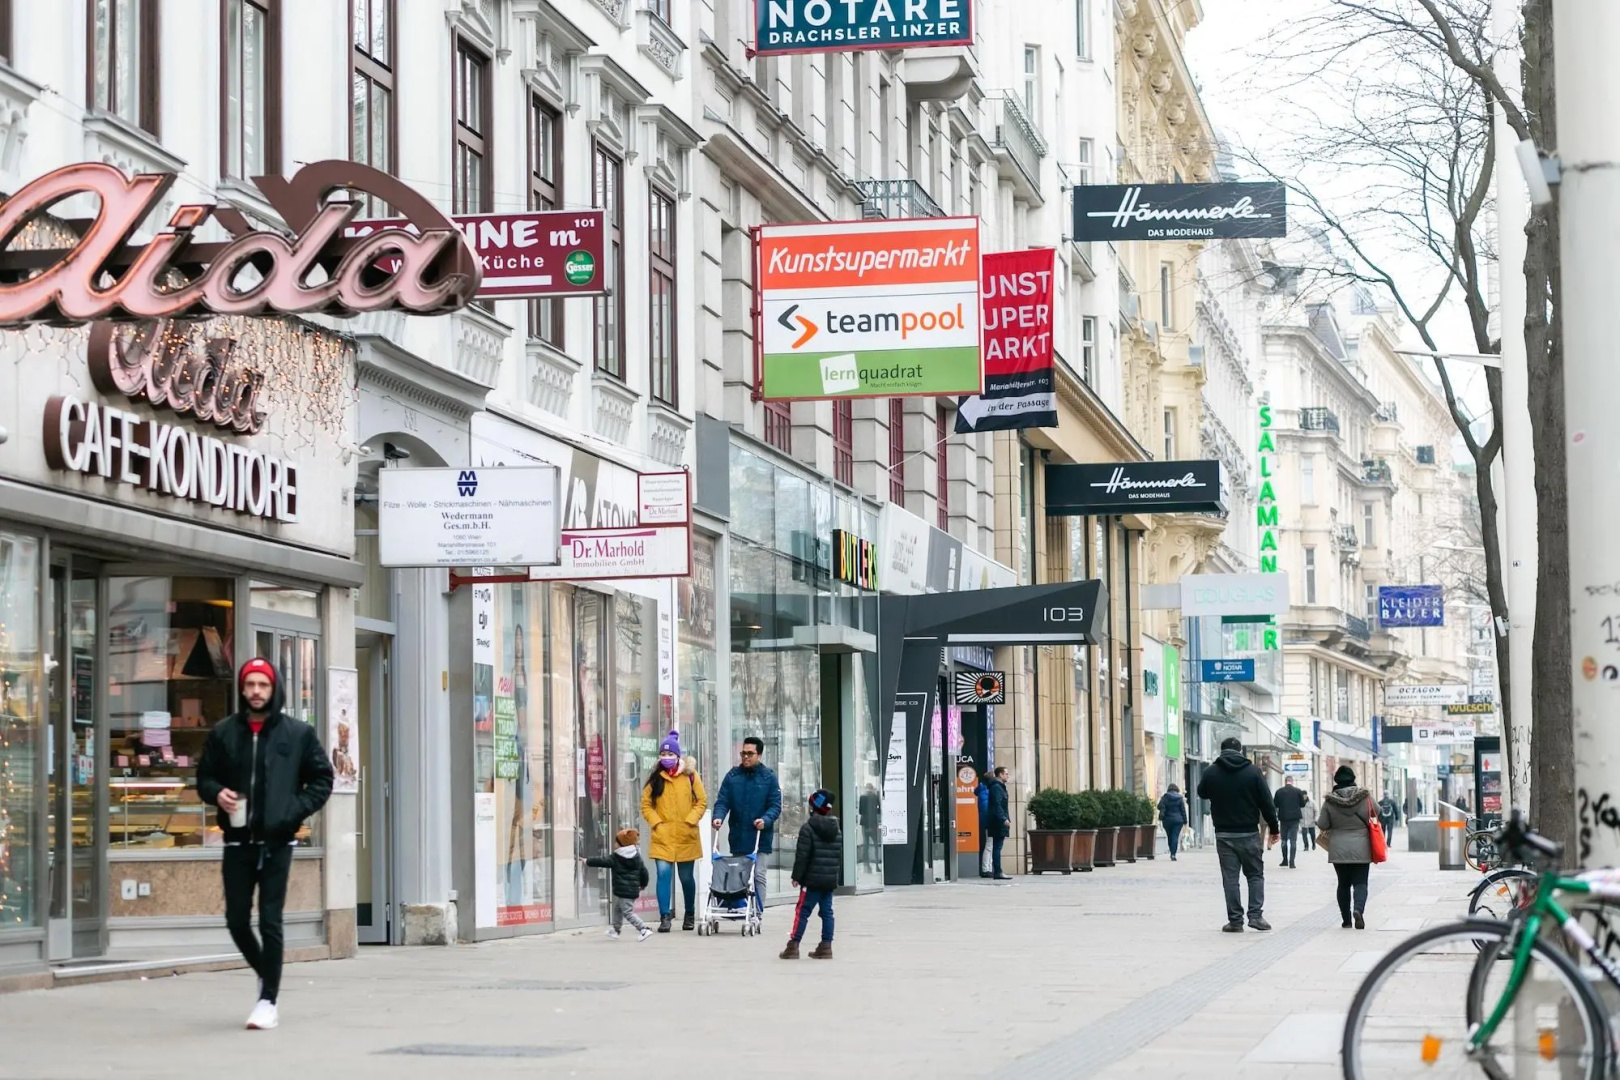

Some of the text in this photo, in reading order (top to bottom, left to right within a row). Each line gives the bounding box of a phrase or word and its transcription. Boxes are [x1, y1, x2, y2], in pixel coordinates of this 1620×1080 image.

[769, 0, 960, 28] NOTARE
[769, 22, 960, 44] DRACHSLER LINZER
[1148, 228, 1214, 237] DAS MODEHAUS
[768, 239, 971, 278] Kunstsupermarkt
[982, 270, 1051, 299] UNST
[826, 302, 965, 340] teampool
[983, 304, 1049, 331] UPER
[986, 332, 1050, 361] ARKT
[998, 402, 1014, 411] der
[1017, 400, 1050, 410] Passage
[1090, 467, 1207, 494] Hämmerle
[441, 512, 494, 521] Wedermann
[443, 521, 491, 530] Ges.m.b.H.
[573, 539, 644, 559] Dr. Marhold
[573, 558, 645, 568] Immobilien GmbH
[839, 529, 878, 592] BUTLERS
[1194, 586, 1274, 605] DOUGLAS
[1381, 597, 1440, 608] KLEIDER
[1043, 607, 1083, 622] 103
[1382, 608, 1441, 619] BAUER
